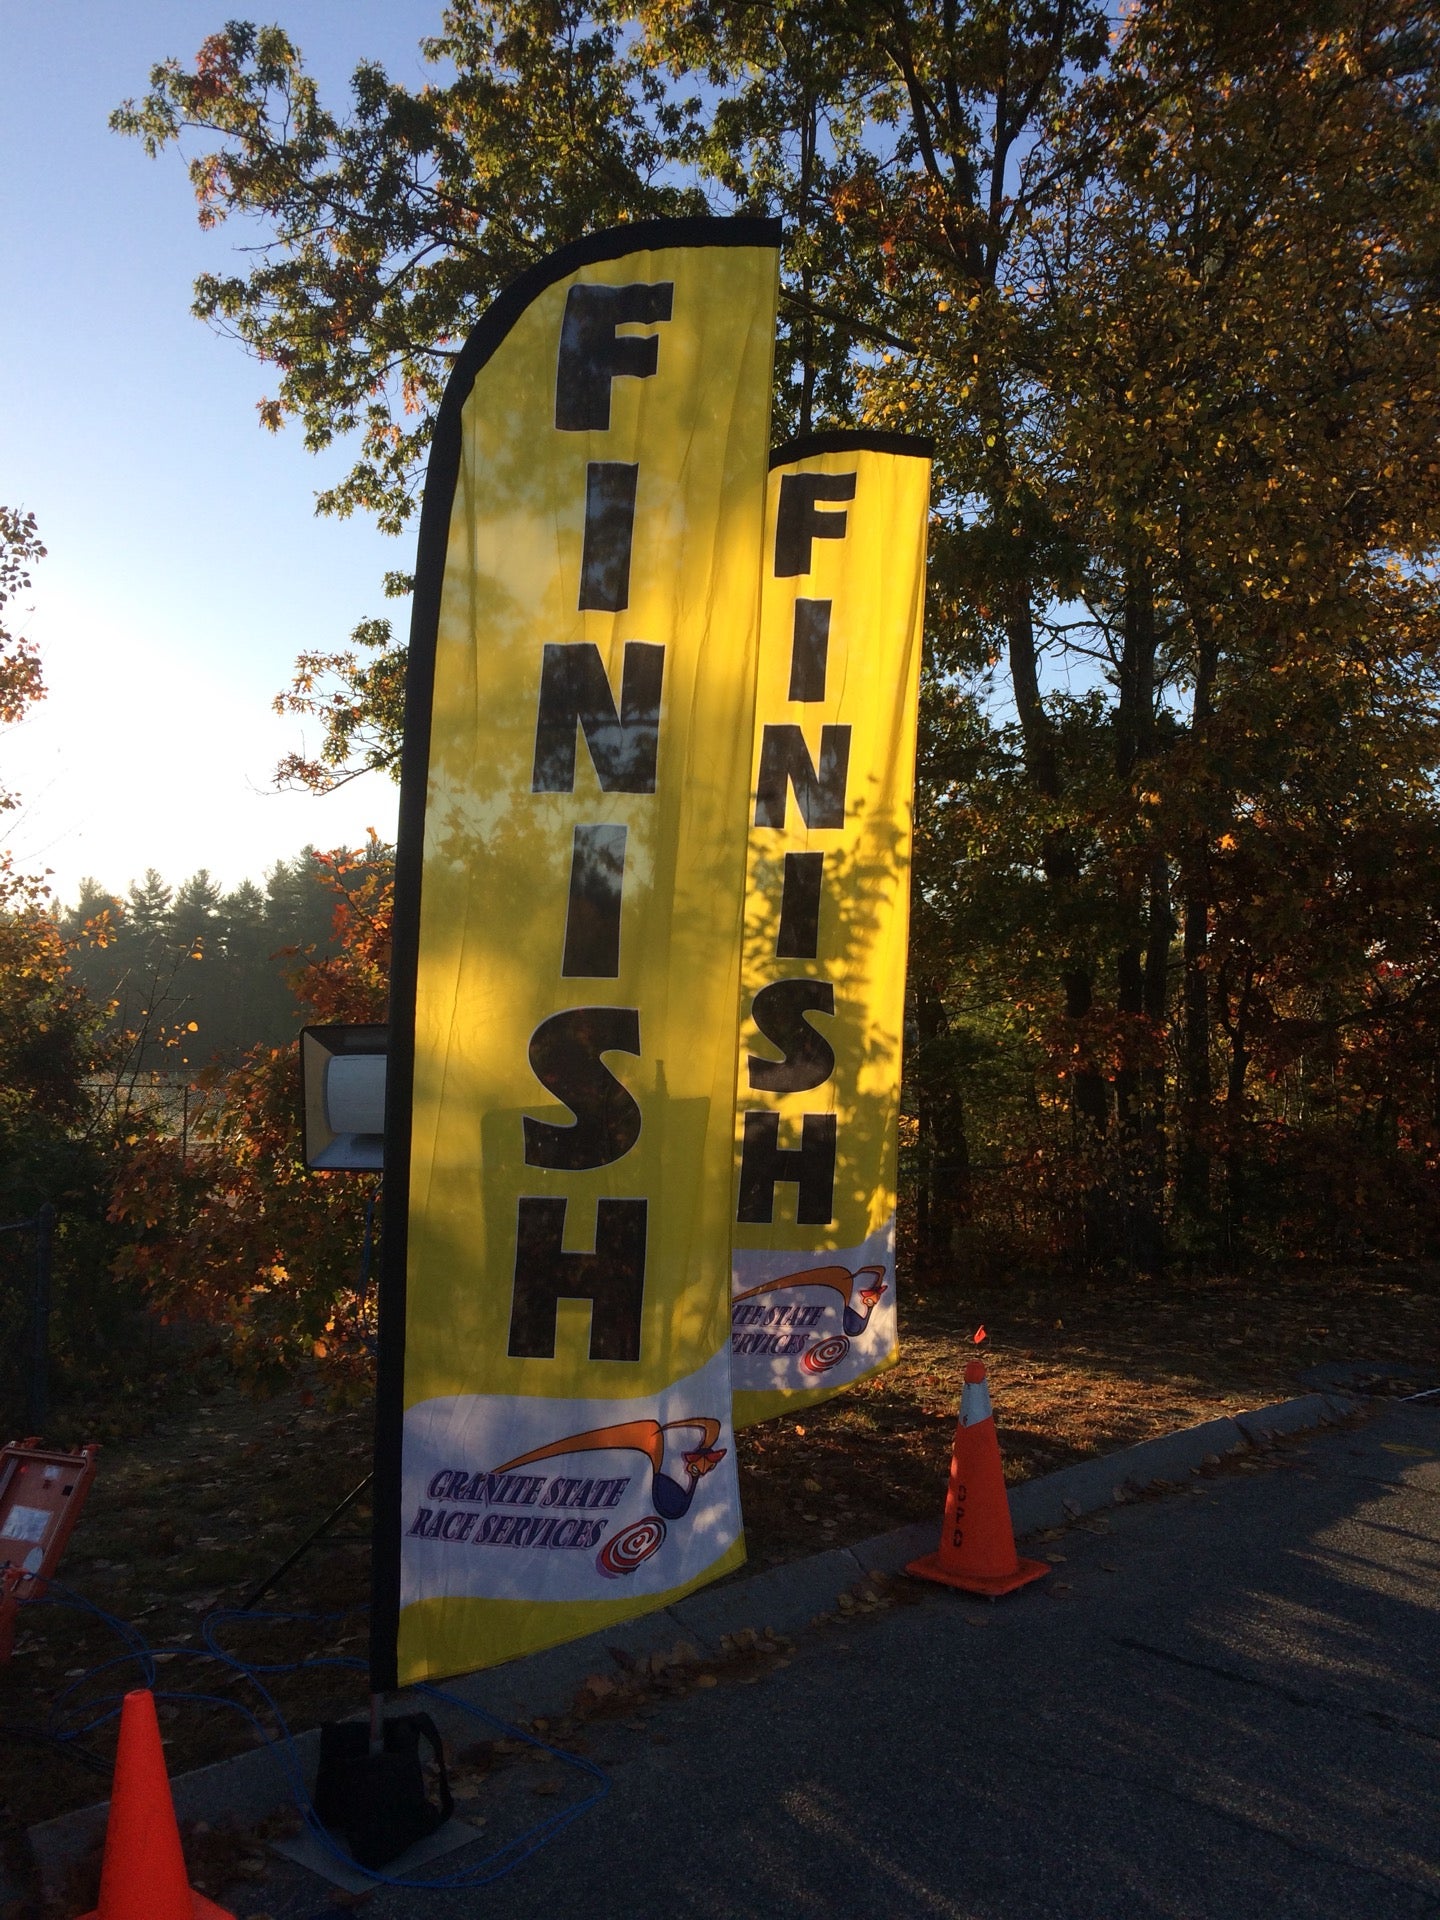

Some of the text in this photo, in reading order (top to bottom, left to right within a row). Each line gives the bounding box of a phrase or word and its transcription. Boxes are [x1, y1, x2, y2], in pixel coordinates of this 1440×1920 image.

[507, 282, 674, 1361] FINISH
[736, 472, 857, 1225] FINISH
[762, 1306, 826, 1328] STATE
[732, 1333, 810, 1355] ERVICES
[427, 1469, 631, 1509] GRANITE STATE
[406, 1506, 609, 1550] RACE SERVICES
